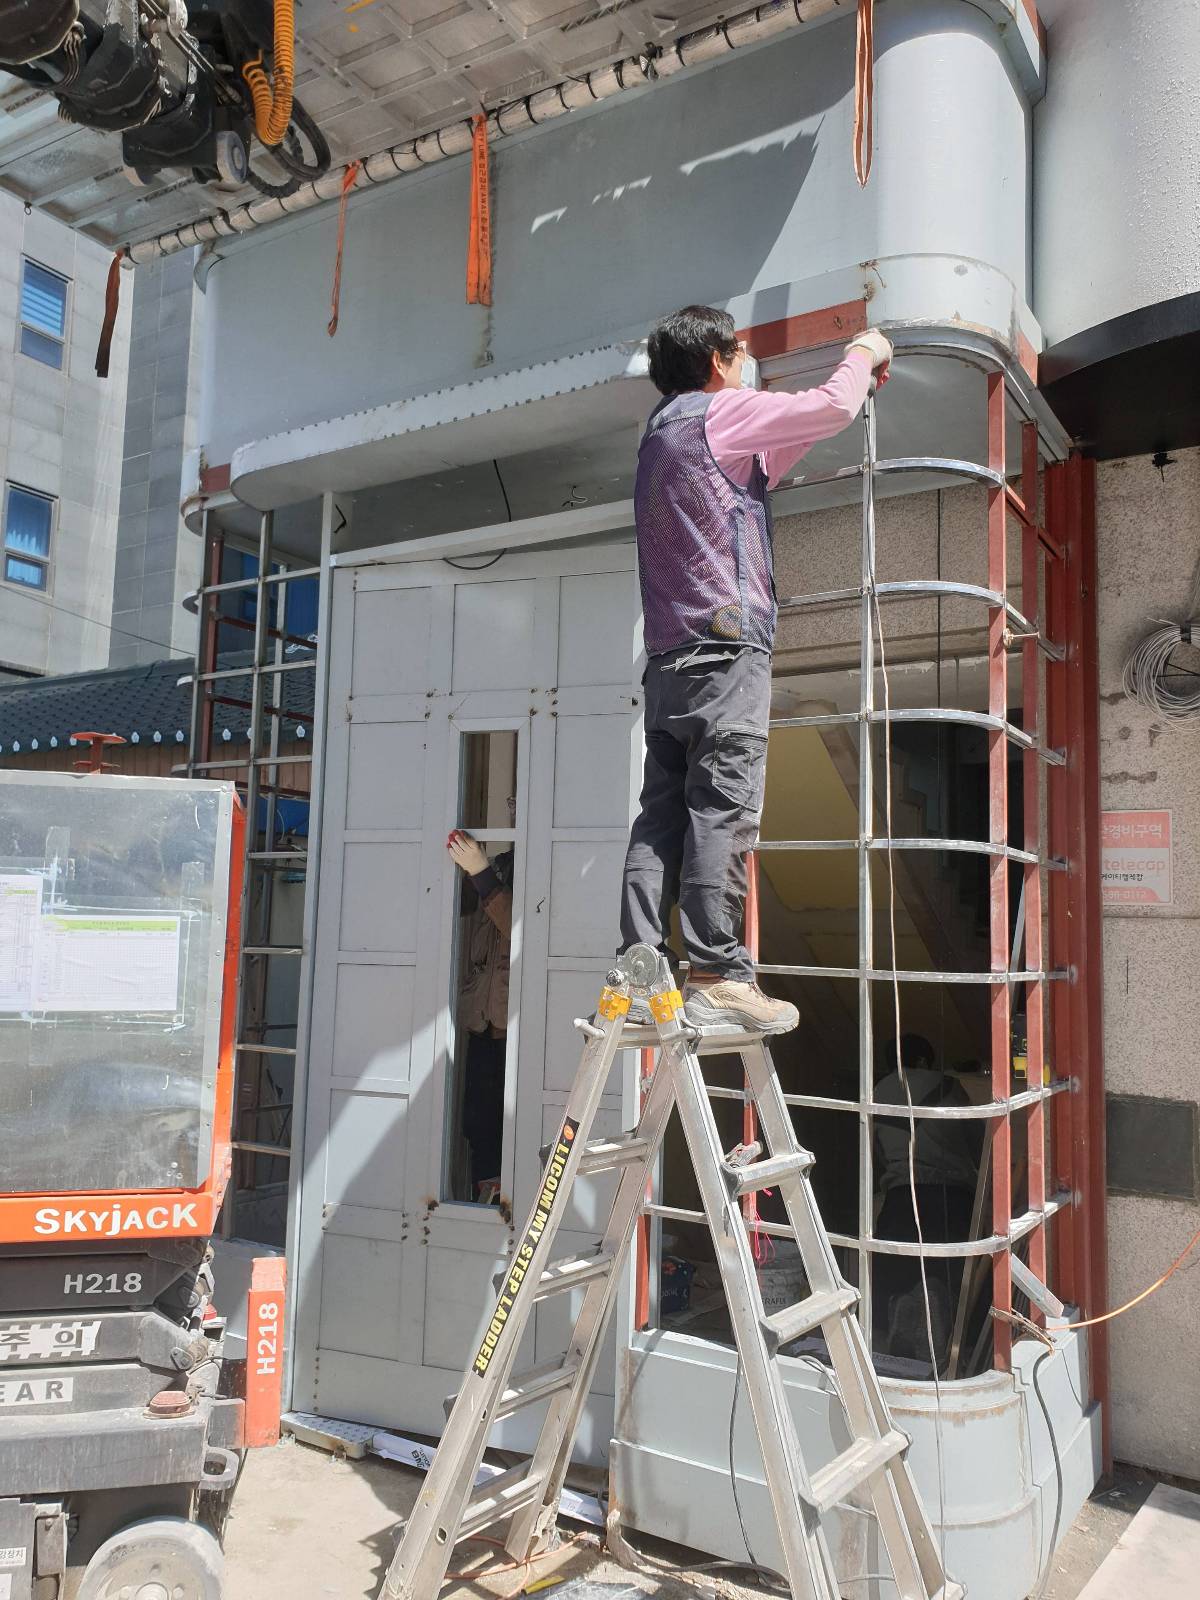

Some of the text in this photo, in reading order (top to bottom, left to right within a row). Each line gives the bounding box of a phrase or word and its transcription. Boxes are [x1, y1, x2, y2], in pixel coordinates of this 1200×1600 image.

[64, 1272, 142, 1295] H218
[475, 1142, 570, 1374] LICOM MY STEP LADDER
[256, 1301, 279, 1376] H218
